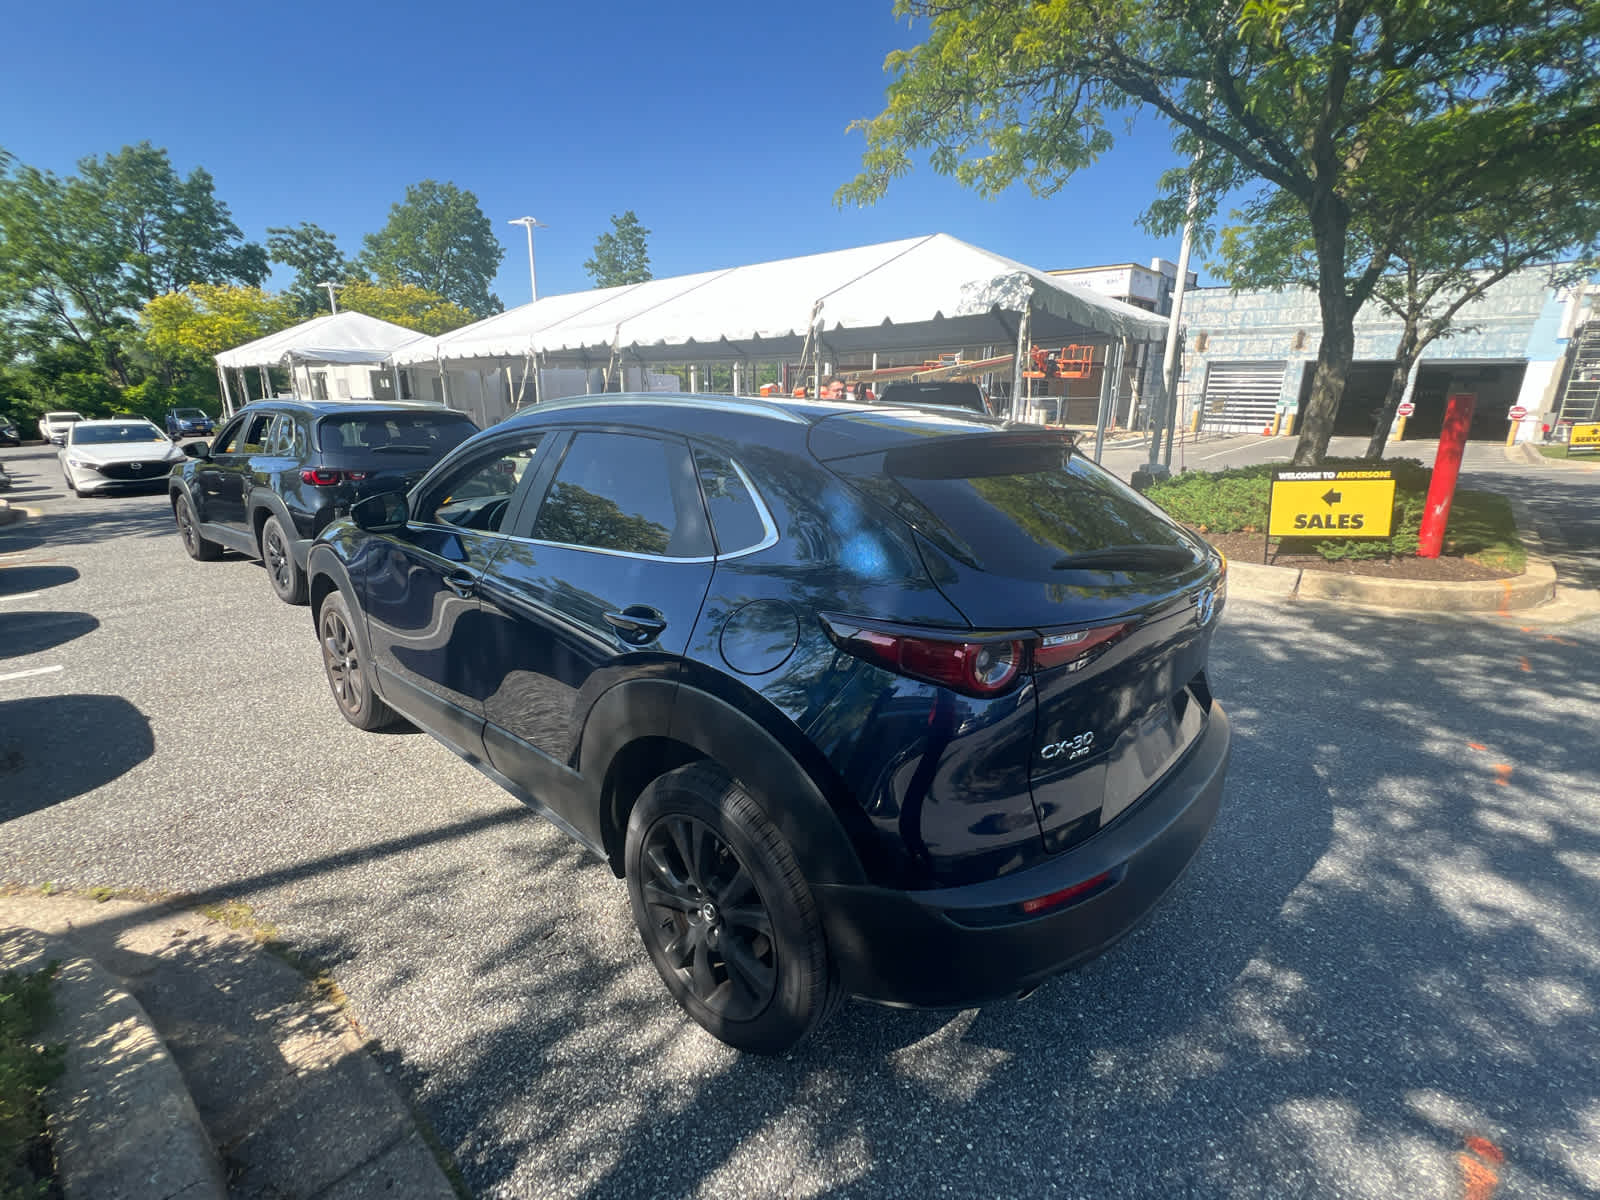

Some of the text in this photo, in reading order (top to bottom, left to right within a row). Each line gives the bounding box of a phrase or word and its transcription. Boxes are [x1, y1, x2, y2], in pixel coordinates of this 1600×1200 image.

[1278, 472, 1321, 480] WELCOME
[1294, 514, 1364, 529] SALES
[1041, 731, 1094, 759] CX-30
